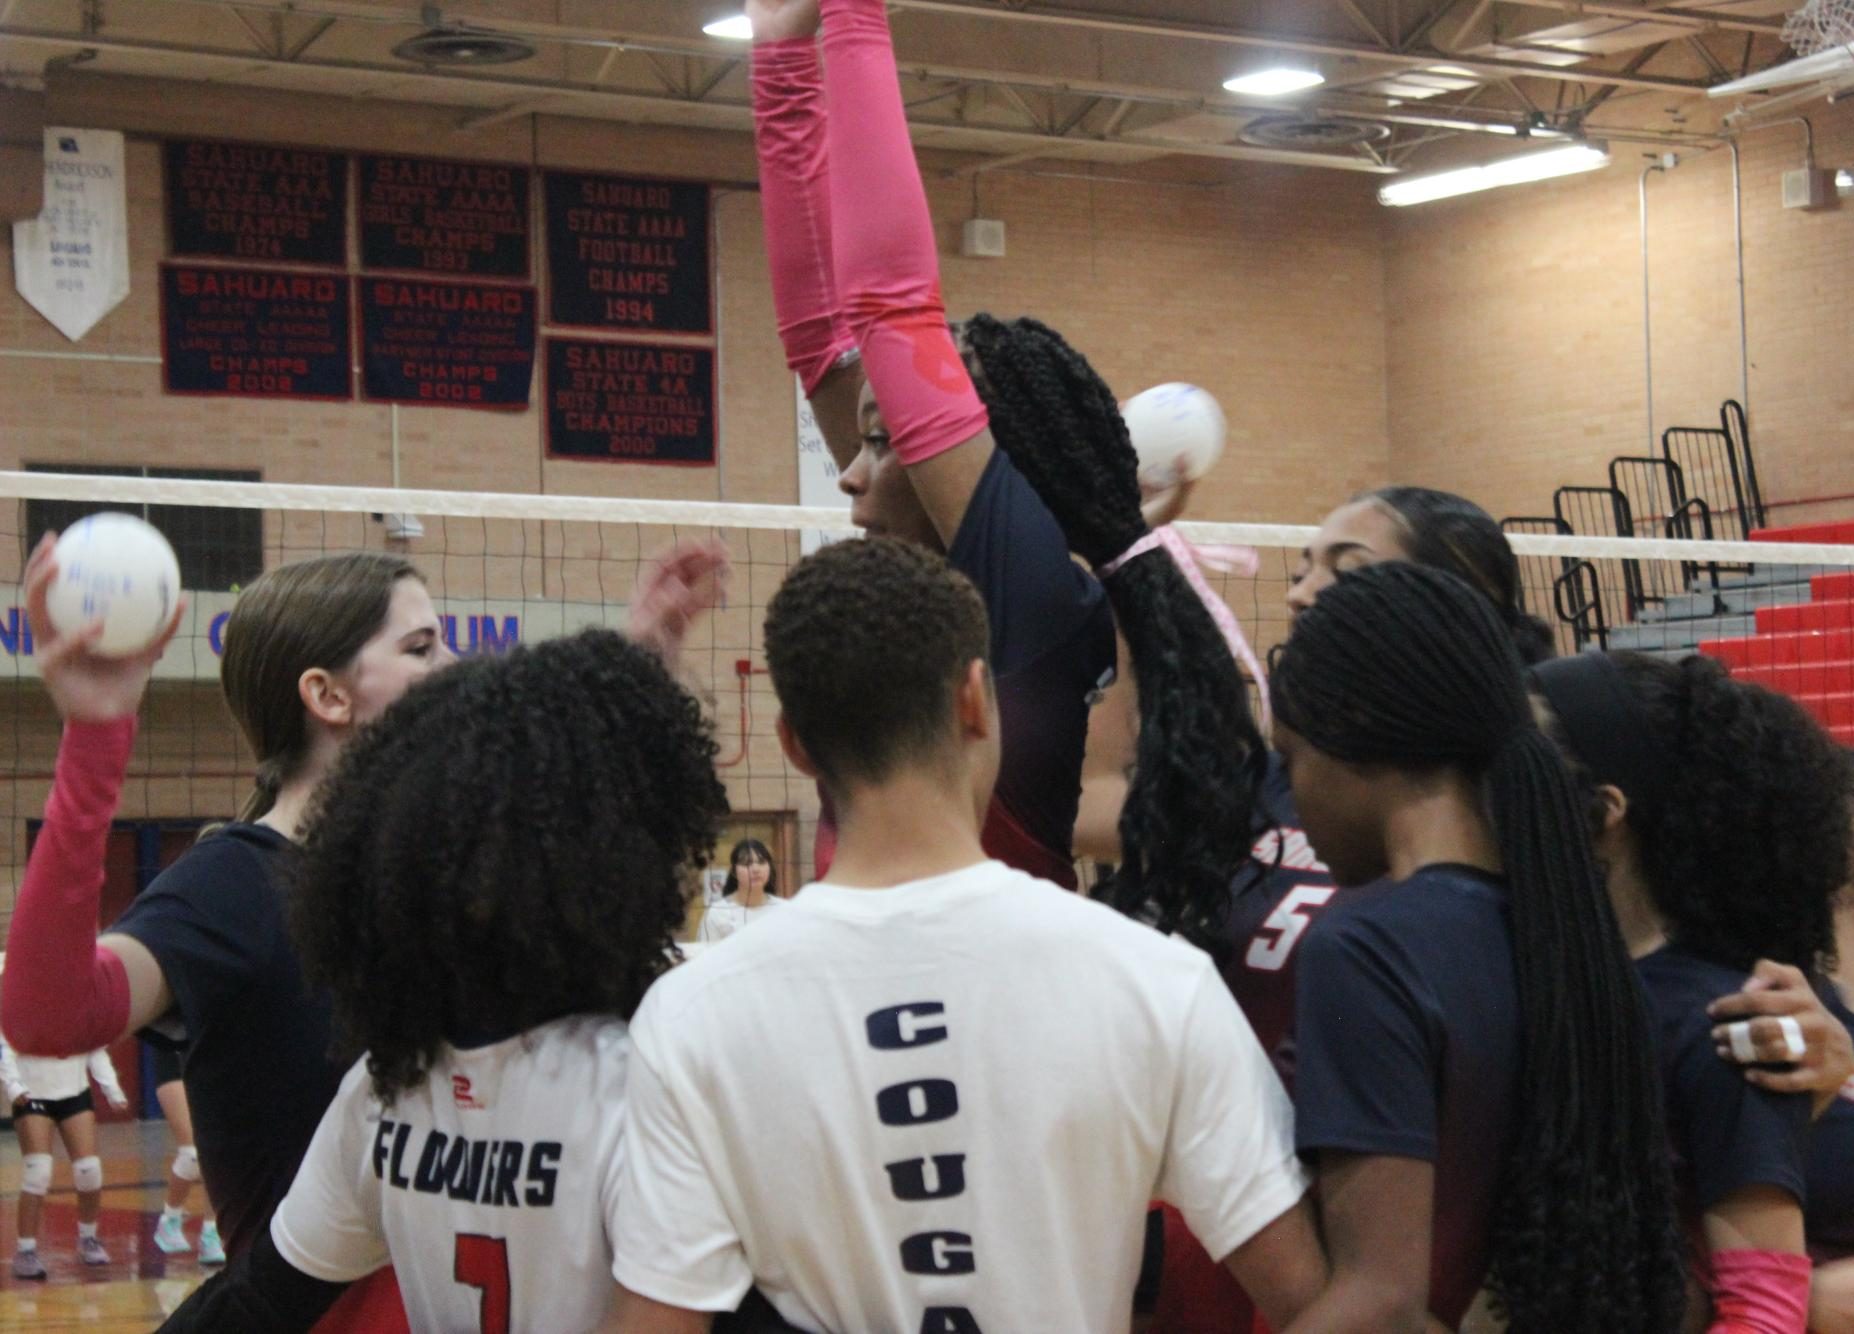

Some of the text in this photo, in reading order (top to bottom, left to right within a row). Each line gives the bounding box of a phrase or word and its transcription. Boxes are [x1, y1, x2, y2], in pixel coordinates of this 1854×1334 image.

[582, 180, 671, 209] SAHUARO
[567, 208, 687, 238] STATE AAAA
[578, 237, 678, 267] FOOTBALL
[177, 270, 337, 302] SAHUARO
[588, 267, 669, 295] CHAMPS
[375, 283, 522, 315] SAHUARO
[606, 298, 654, 322] 1994
[210, 355, 309, 375] CHAMPS
[403, 362, 497, 382] CHAMPS
[566, 347, 694, 374] SAHUARO
[574, 371, 648, 392] STATE
[566, 412, 697, 436] CHAMPIONS
[1246, 884, 1338, 971] 5
